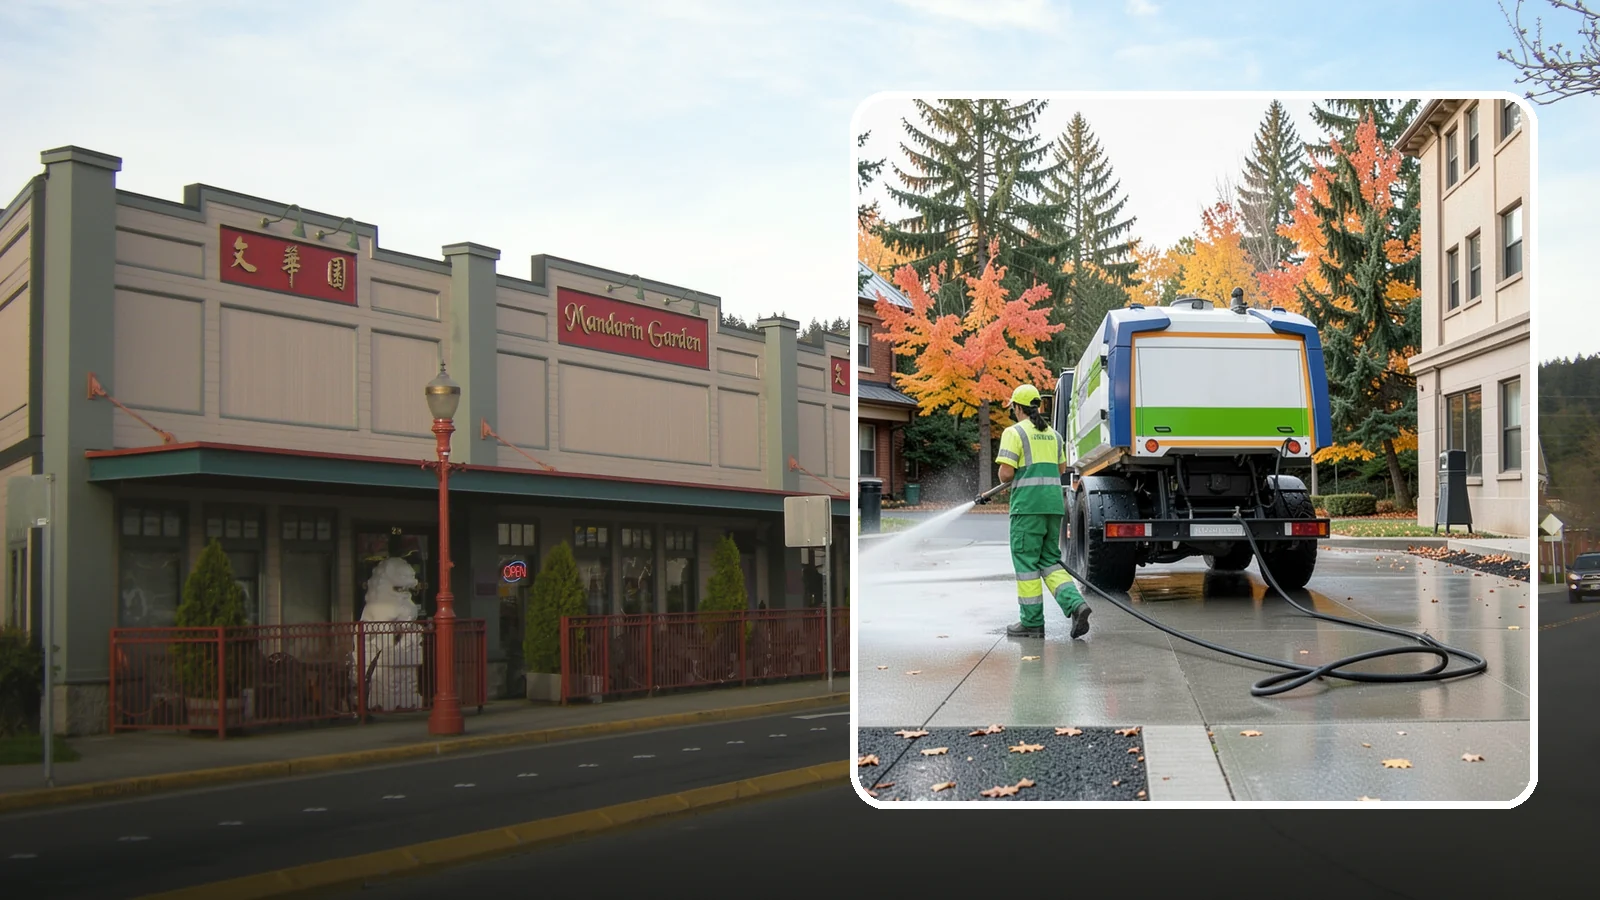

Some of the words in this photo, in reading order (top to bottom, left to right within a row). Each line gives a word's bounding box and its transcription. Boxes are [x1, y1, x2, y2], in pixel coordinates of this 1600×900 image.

[231, 236, 346, 290] 文華園
[564, 302, 644, 341] Mandarin
[648, 320, 701, 352] Garden
[503, 565, 527, 578] OPEN
